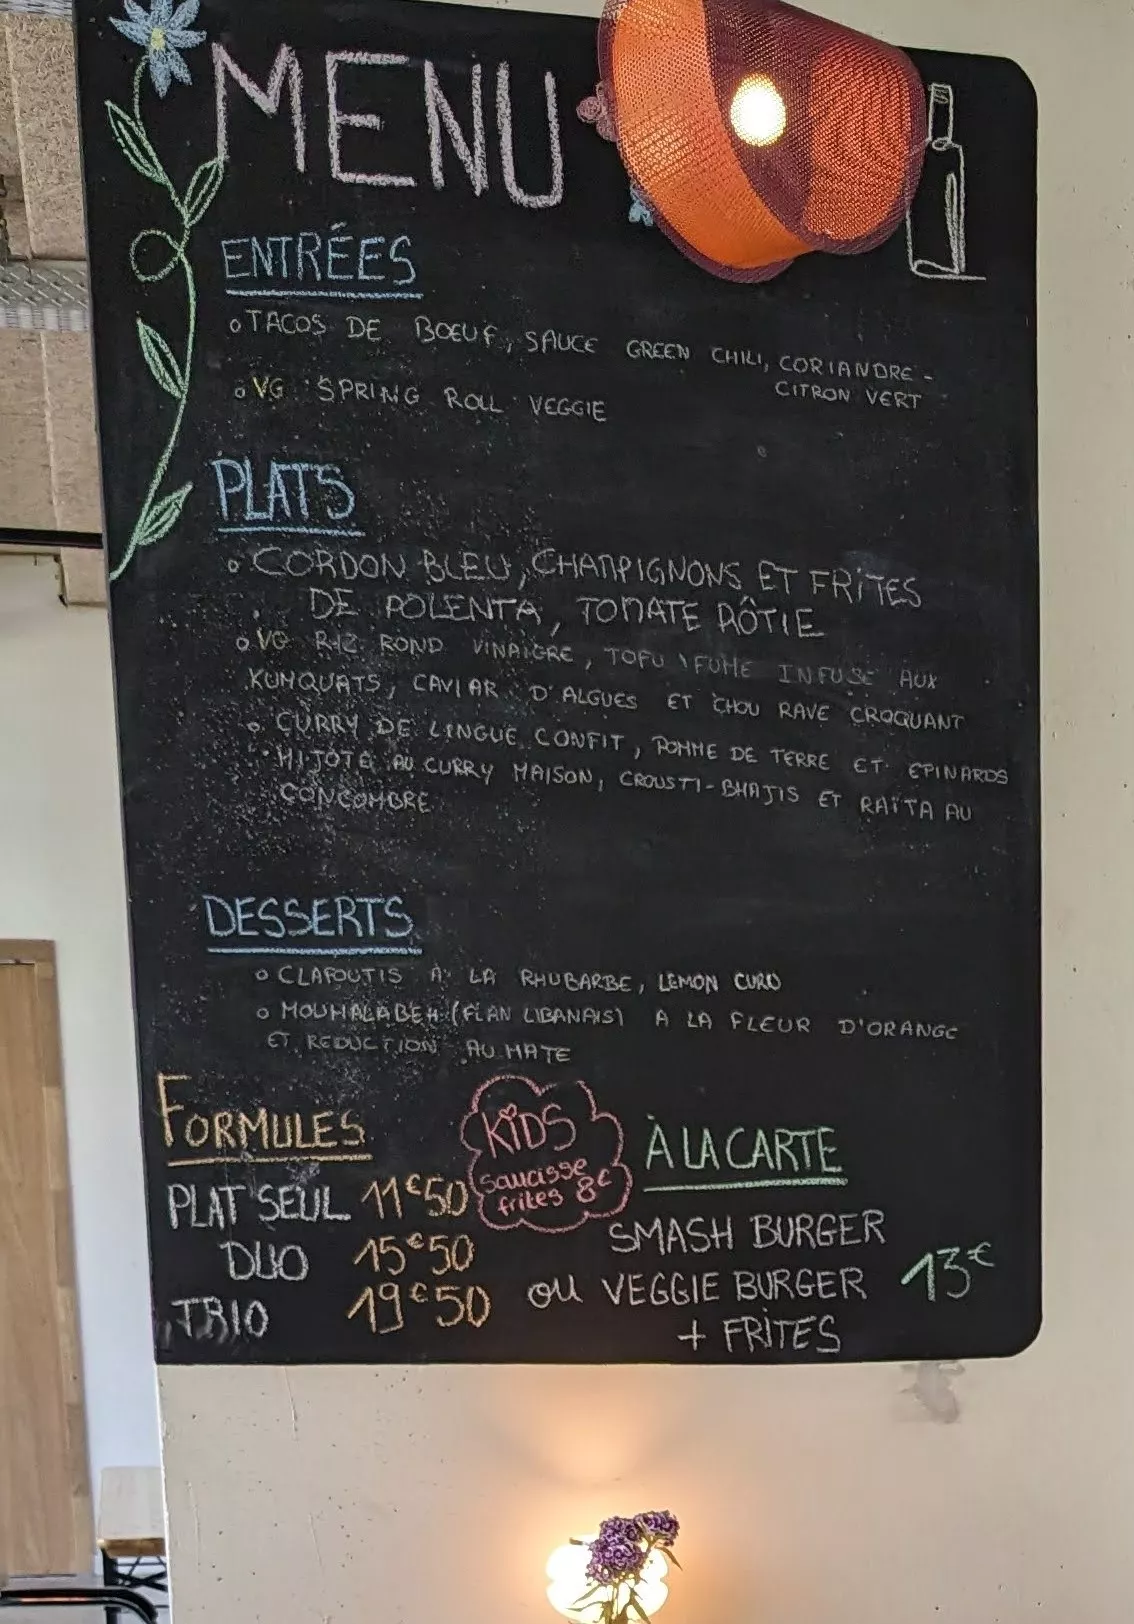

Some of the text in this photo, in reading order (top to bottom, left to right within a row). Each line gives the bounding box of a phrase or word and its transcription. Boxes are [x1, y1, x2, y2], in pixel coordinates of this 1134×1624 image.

[210, 44, 565, 209] MENU
[220, 222, 418, 285] ENTRÉES
[246, 308, 327, 337] TACOS
[345, 315, 382, 342] DE
[524, 330, 600, 354] SAUCE
[626, 339, 691, 361] GREEN
[778, 355, 914, 382] CORIANDRE
[316, 376, 420, 405] SPRING
[443, 386, 504, 413] ROLL
[528, 394, 608, 423] VEGGIE
[774, 380, 923, 409] CITRON VERT
[212, 459, 356, 521] PLATS
[252, 546, 407, 580] CORDON
[531, 548, 741, 590] CHAMPIGNONS
[757, 560, 798, 594] ET
[309, 587, 358, 620] DE
[576, 596, 701, 632] TOMATE
[380, 634, 443, 654] ROND
[605, 647, 665, 669] TOFU
[899, 670, 940, 690] AUX
[413, 673, 500, 699] CAVIAR
[667, 692, 693, 711] ET
[712, 694, 761, 718] CHOU
[778, 700, 831, 722] RAVE
[849, 705, 968, 731] CROQUANT
[275, 710, 361, 740] CURRY
[374, 717, 412, 738] DE
[429, 720, 518, 747] LINGUE
[651, 735, 719, 760] POMME
[730, 744, 760, 764] DE
[770, 748, 831, 771] TERRE
[853, 757, 885, 775] ET
[390, 752, 415, 772] AU
[423, 756, 495, 786] CURRY
[817, 789, 844, 809] ET
[945, 802, 974, 823] AU
[203, 895, 416, 938] DESSERTS
[277, 964, 404, 987] CLAFOUTIS
[468, 967, 498, 986] LA
[656, 971, 720, 994] LEMON
[266, 1031, 292, 1049] ET
[466, 1039, 496, 1060] AU
[686, 1010, 714, 1031] LA
[730, 1011, 811, 1034] FLEUR
[681, 1127, 720, 1171] LA
[724, 1126, 843, 1173] CARTE
[480, 1158, 588, 1194] saucisse
[167, 1183, 250, 1230] PLAT
[257, 1184, 352, 1221] SEUL
[498, 1188, 564, 1216] frites
[608, 1209, 886, 1256] SMASH BURGER
[219, 1240, 310, 1283] DUO
[601, 1273, 721, 1307] VEGGIE
[734, 1268, 867, 1303] BURGER
[170, 1295, 270, 1345] TRIO
